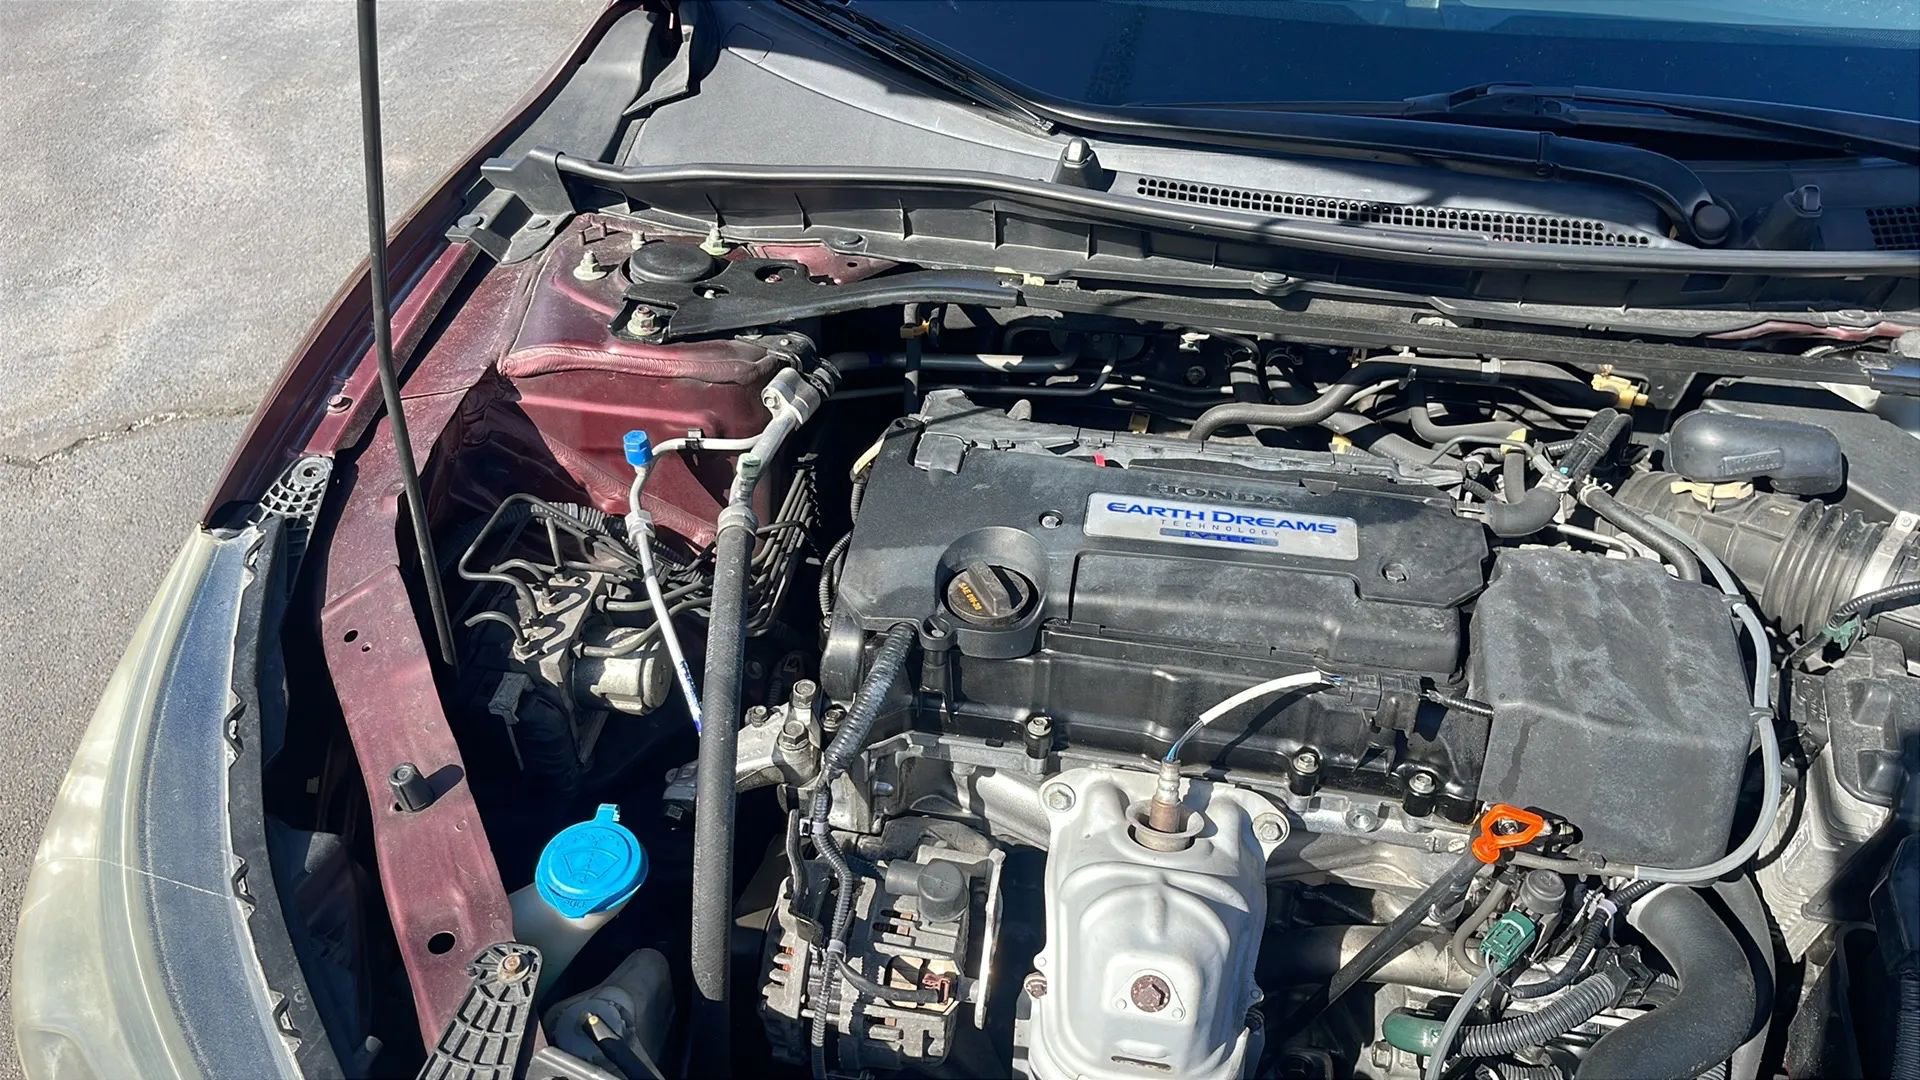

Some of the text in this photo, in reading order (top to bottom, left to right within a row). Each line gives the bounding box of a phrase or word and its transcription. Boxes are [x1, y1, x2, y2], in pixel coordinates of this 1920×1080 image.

[1148, 483, 1292, 507] HONDA
[1107, 502, 1204, 521] EARTH
[1160, 519, 1280, 537] TECHNOLOGY
